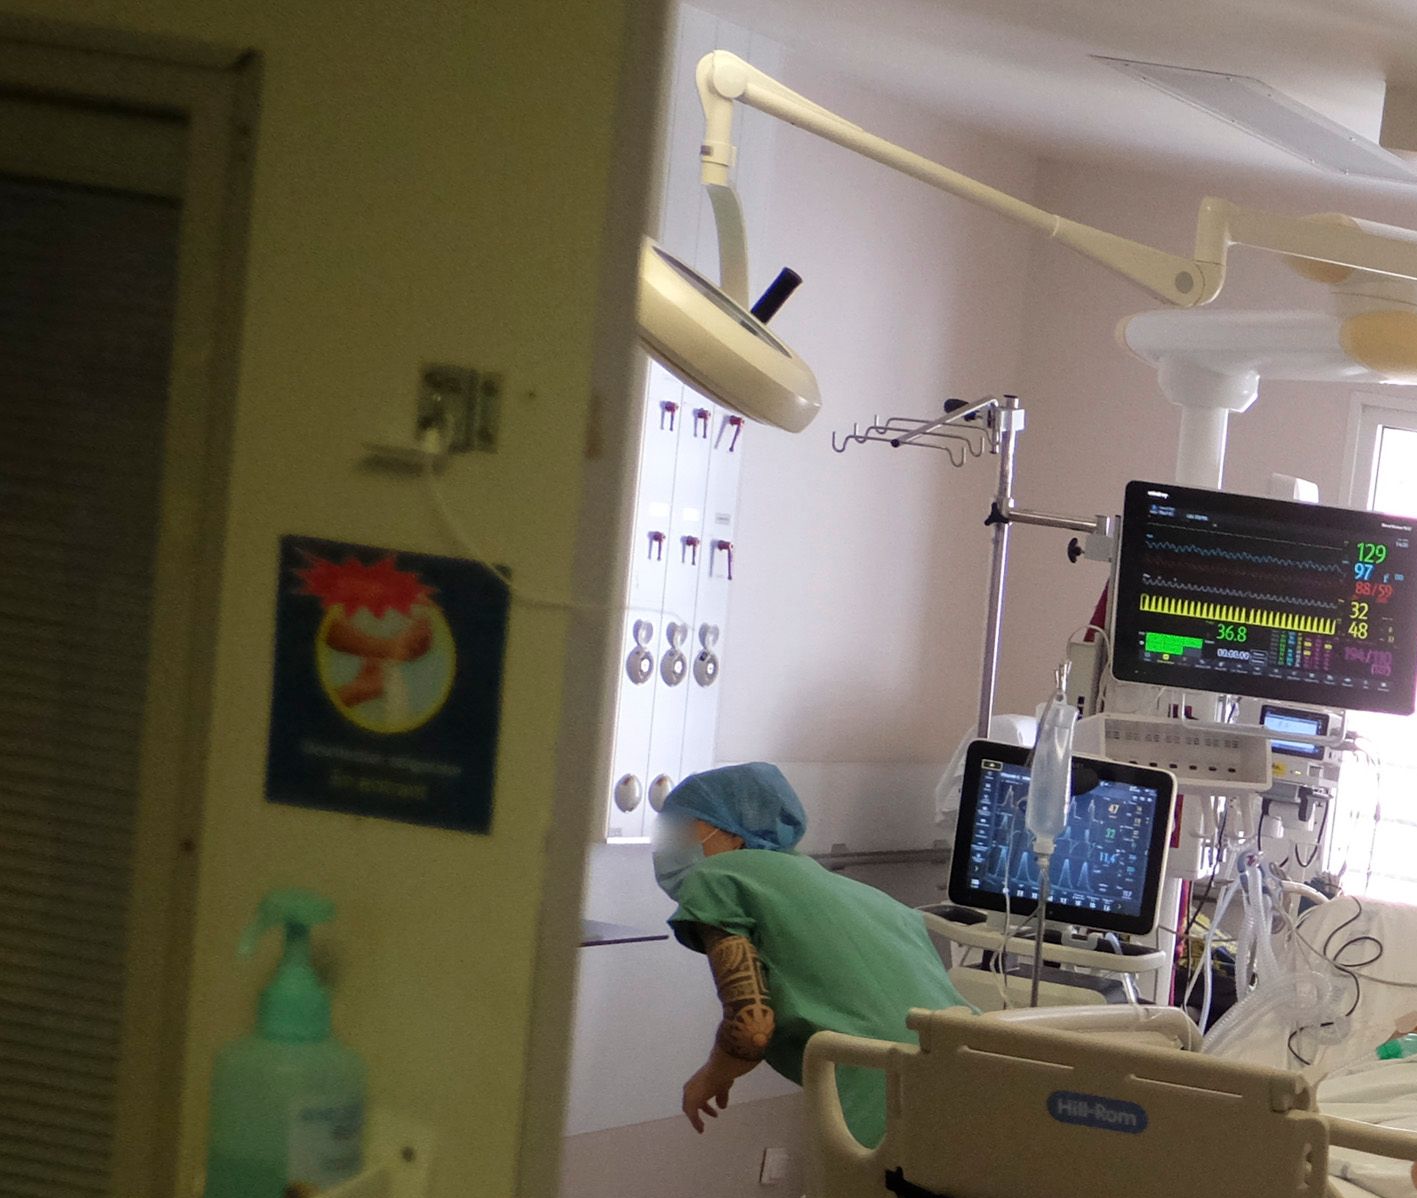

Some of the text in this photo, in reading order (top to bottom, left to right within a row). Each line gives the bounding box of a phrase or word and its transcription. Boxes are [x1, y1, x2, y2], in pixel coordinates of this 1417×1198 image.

[1356, 542, 1387, 565] 129
[1354, 562, 1374, 580] 97
[1348, 601, 1369, 620] 32
[1216, 623, 1248, 643] 36.8
[1347, 620, 1369, 639] 48
[1057, 1098, 1137, 1127] Hill-Rom
